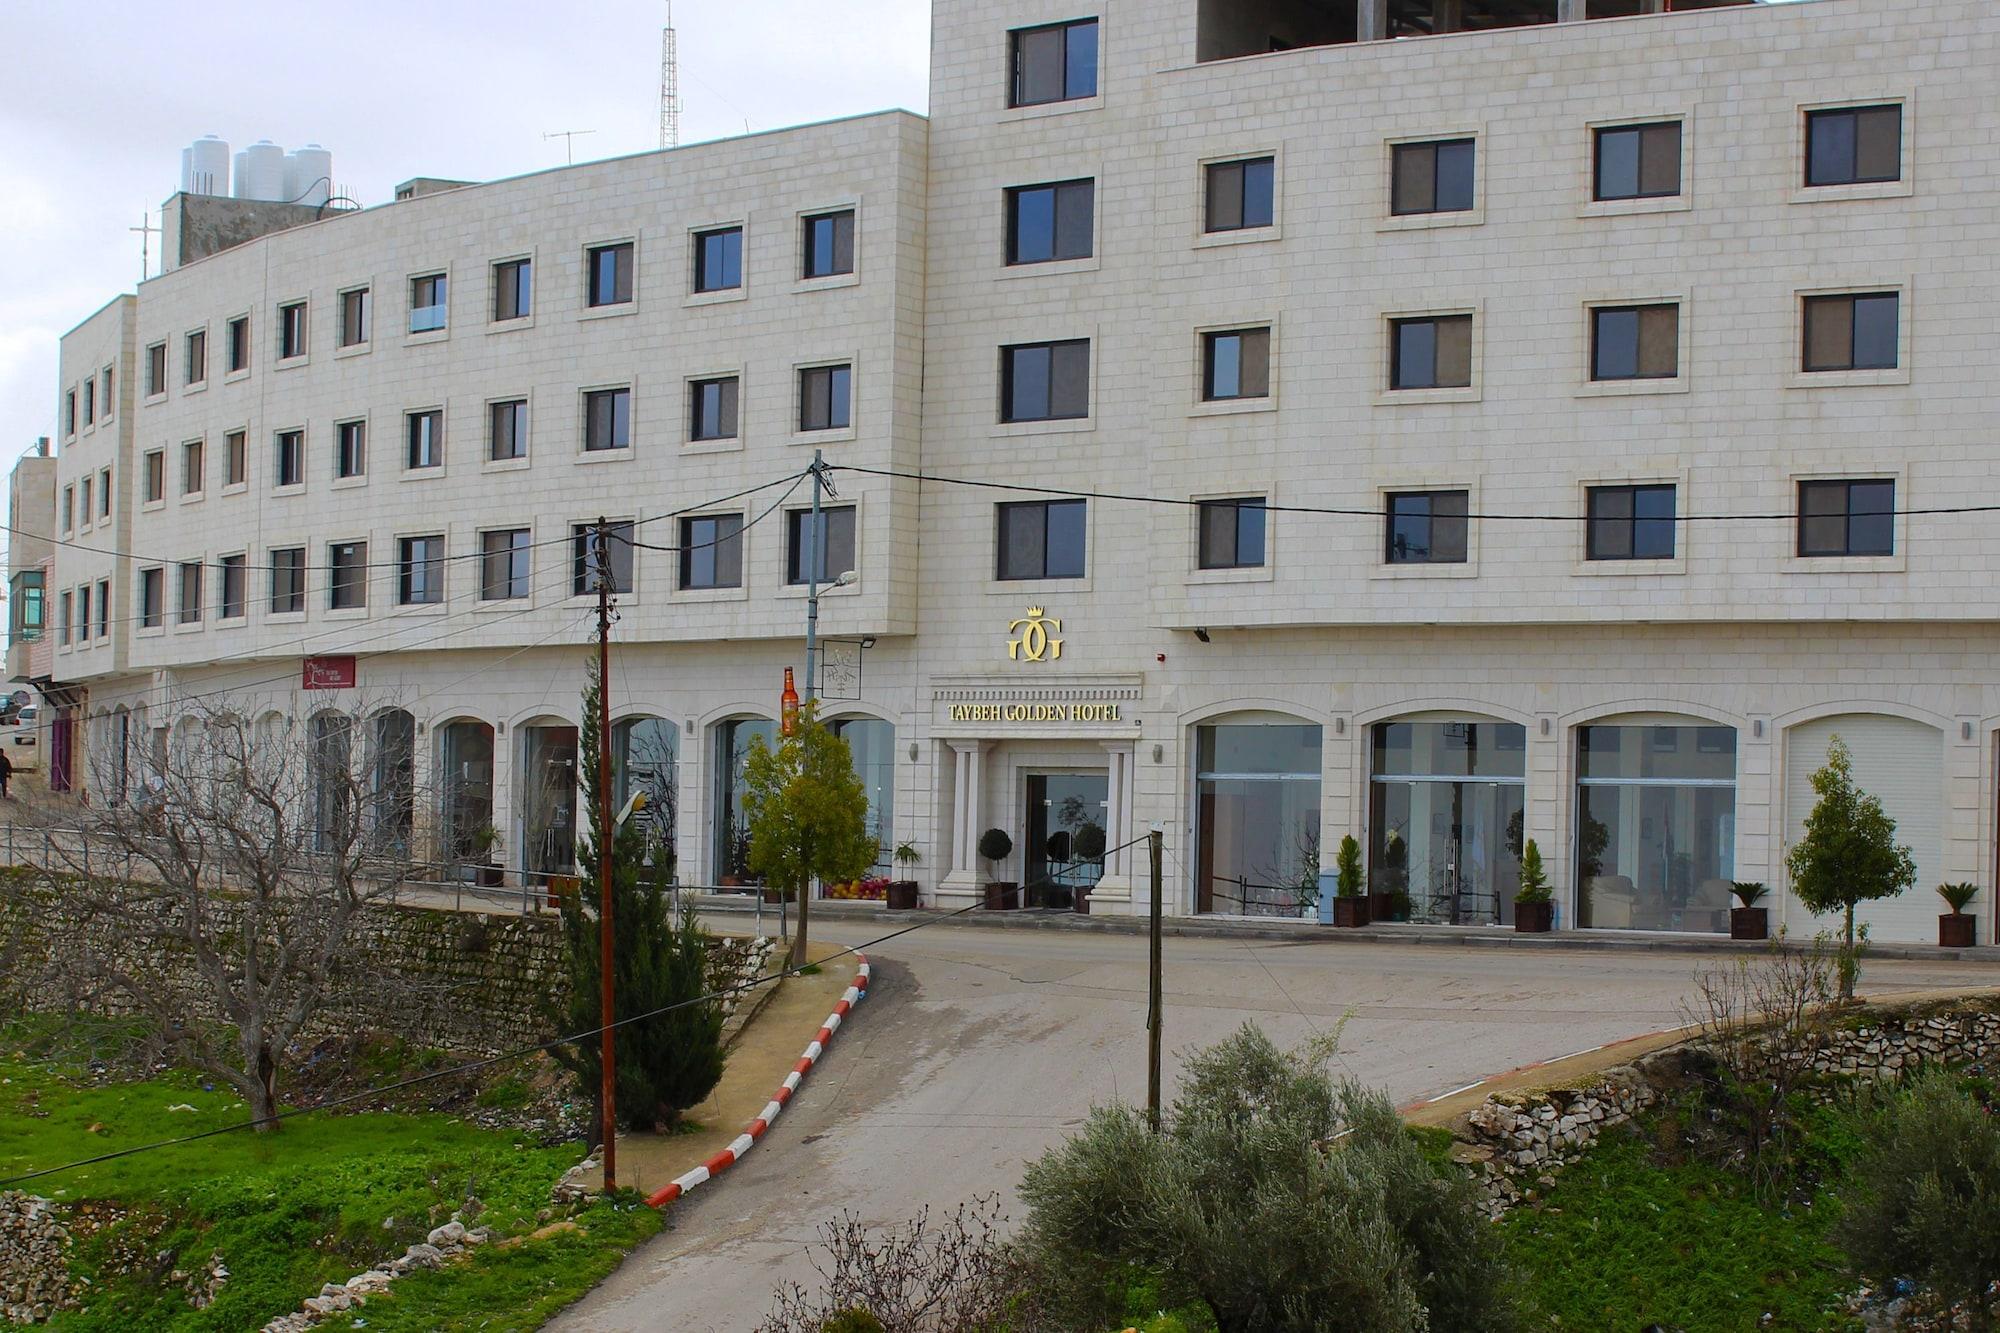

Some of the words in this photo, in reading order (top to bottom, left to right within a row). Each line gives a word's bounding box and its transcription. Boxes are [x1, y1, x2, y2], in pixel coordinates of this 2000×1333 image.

[948, 704, 1001, 721] TAYBEH
[1004, 704, 1067, 721] GOLDEN
[1071, 704, 1122, 721] HOTEL
